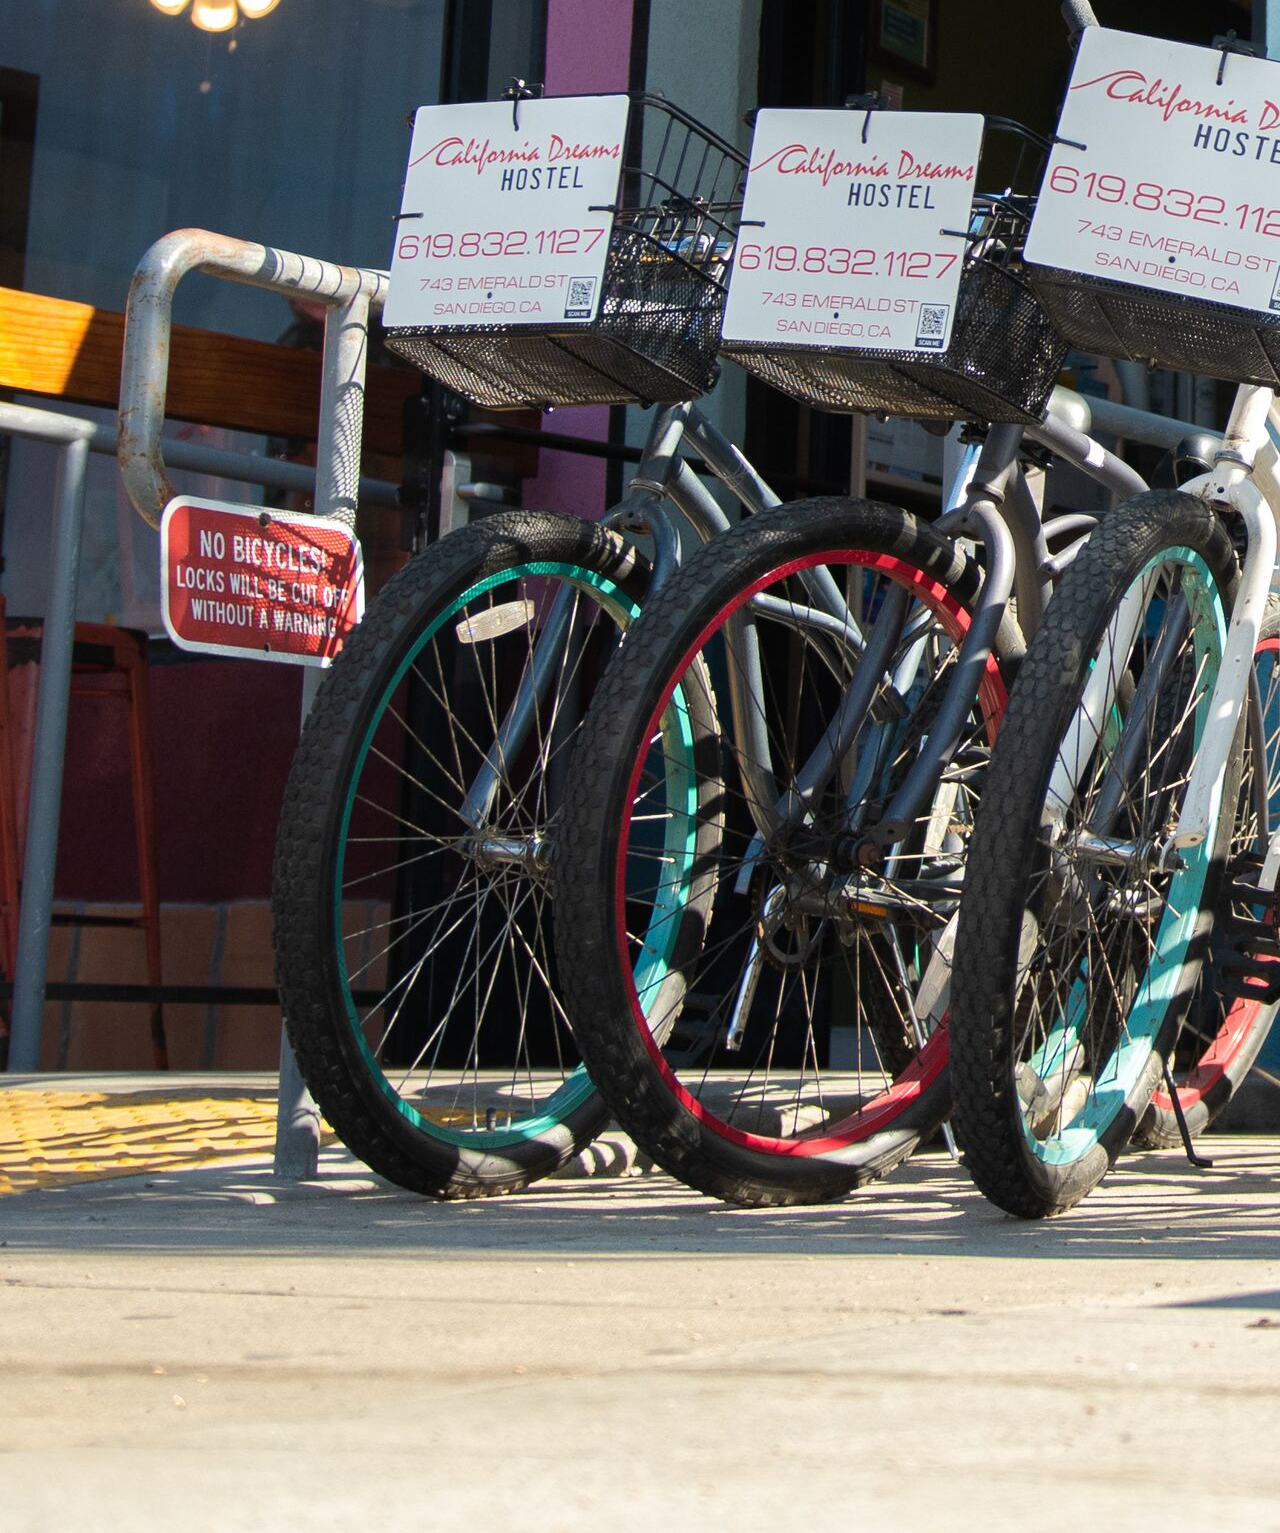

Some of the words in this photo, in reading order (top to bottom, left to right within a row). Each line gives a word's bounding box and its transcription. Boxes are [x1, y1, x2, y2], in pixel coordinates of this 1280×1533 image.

[1070, 70, 1248, 124] California
[409, 137, 540, 175] California
[548, 134, 620, 163] Dreams
[750, 144, 889, 186] California
[898, 150, 974, 181] Dreams
[501, 166, 583, 191] HOSTEL
[848, 183, 935, 209] HOSTEL
[398, 229, 605, 260] 619.832.1127
[1076, 219, 1122, 241] 743
[1128, 231, 1242, 266] EMERALD
[1246, 256, 1277, 273] ST
[738, 244, 958, 279] 619.832.1127
[1095, 252, 1140, 273] SAN
[1143, 261, 1209, 290] DIEGO,
[1211, 275, 1240, 294] CA
[419, 278, 453, 291] 743
[457, 275, 543, 290] EMERALD
[543, 274, 568, 288] ST
[433, 302, 467, 316] SAN
[468, 301, 517, 314] DIEGO,
[518, 300, 542, 313] CA
[761, 292, 797, 307] 743
[801, 294, 890, 312] EMERALD
[894, 299, 919, 314] ST
[776, 319, 812, 334] SAN
[814, 321, 865, 338] DIEGO,
[871, 324, 892, 338] CA
[199, 529, 226, 560] NO
[176, 565, 225, 593] LOCKS
[230, 572, 264, 599] WILL
[268, 578, 287, 602] BE
[291, 581, 319, 605] CUT
[191, 598, 254, 627] WITHOUT
[258, 607, 269, 629] A
[273, 609, 337, 637] WARNING
